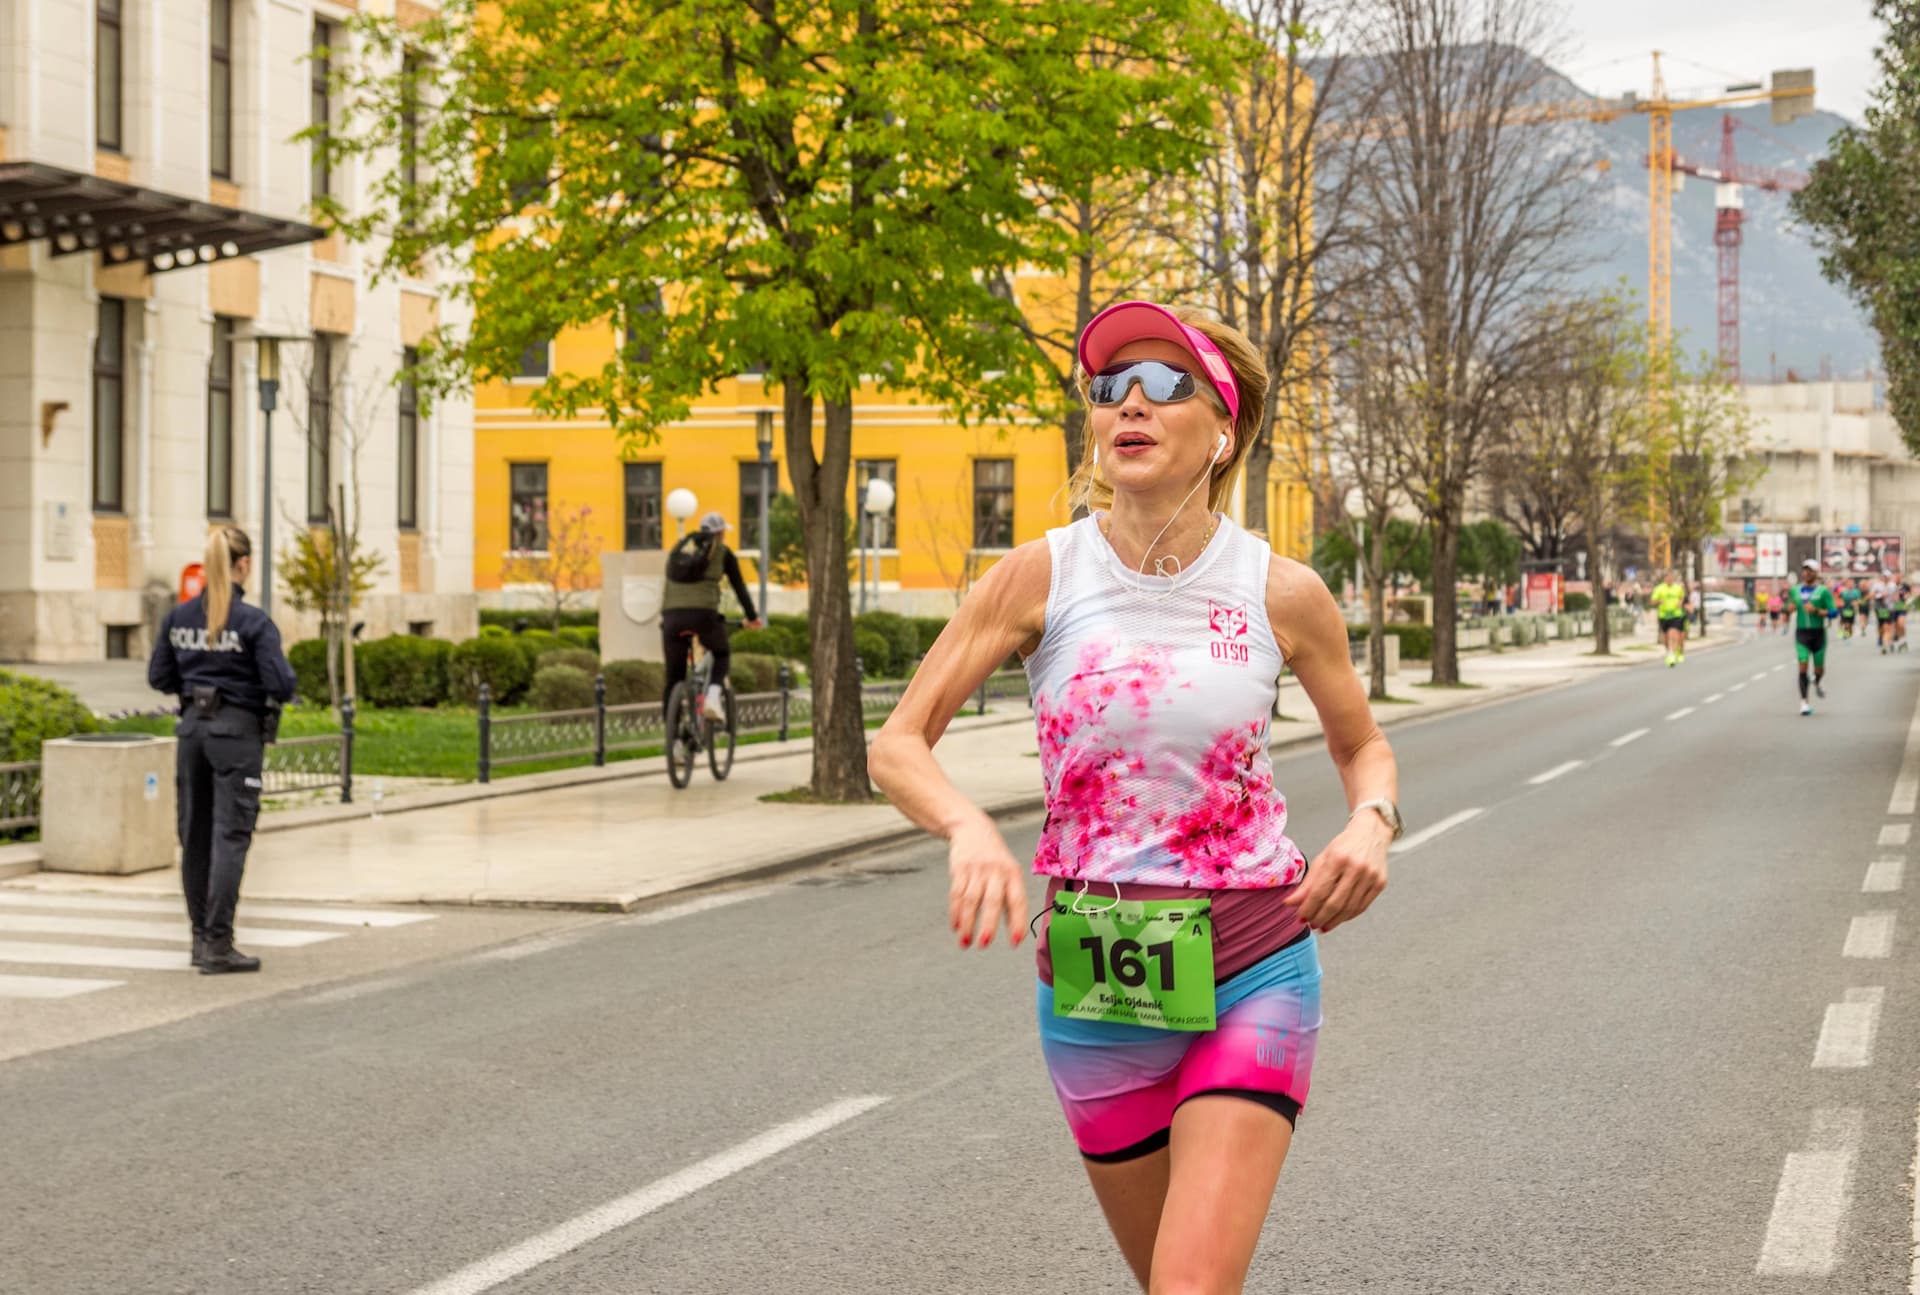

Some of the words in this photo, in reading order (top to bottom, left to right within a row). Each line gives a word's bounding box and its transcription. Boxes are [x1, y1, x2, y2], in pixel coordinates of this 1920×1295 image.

[169, 627, 243, 653] POLICJA
[1210, 641, 1248, 662] OTSO
[1192, 923, 1203, 937] A
[1079, 936, 1175, 992] 161
[1139, 1012, 1185, 1024] MARATHON
